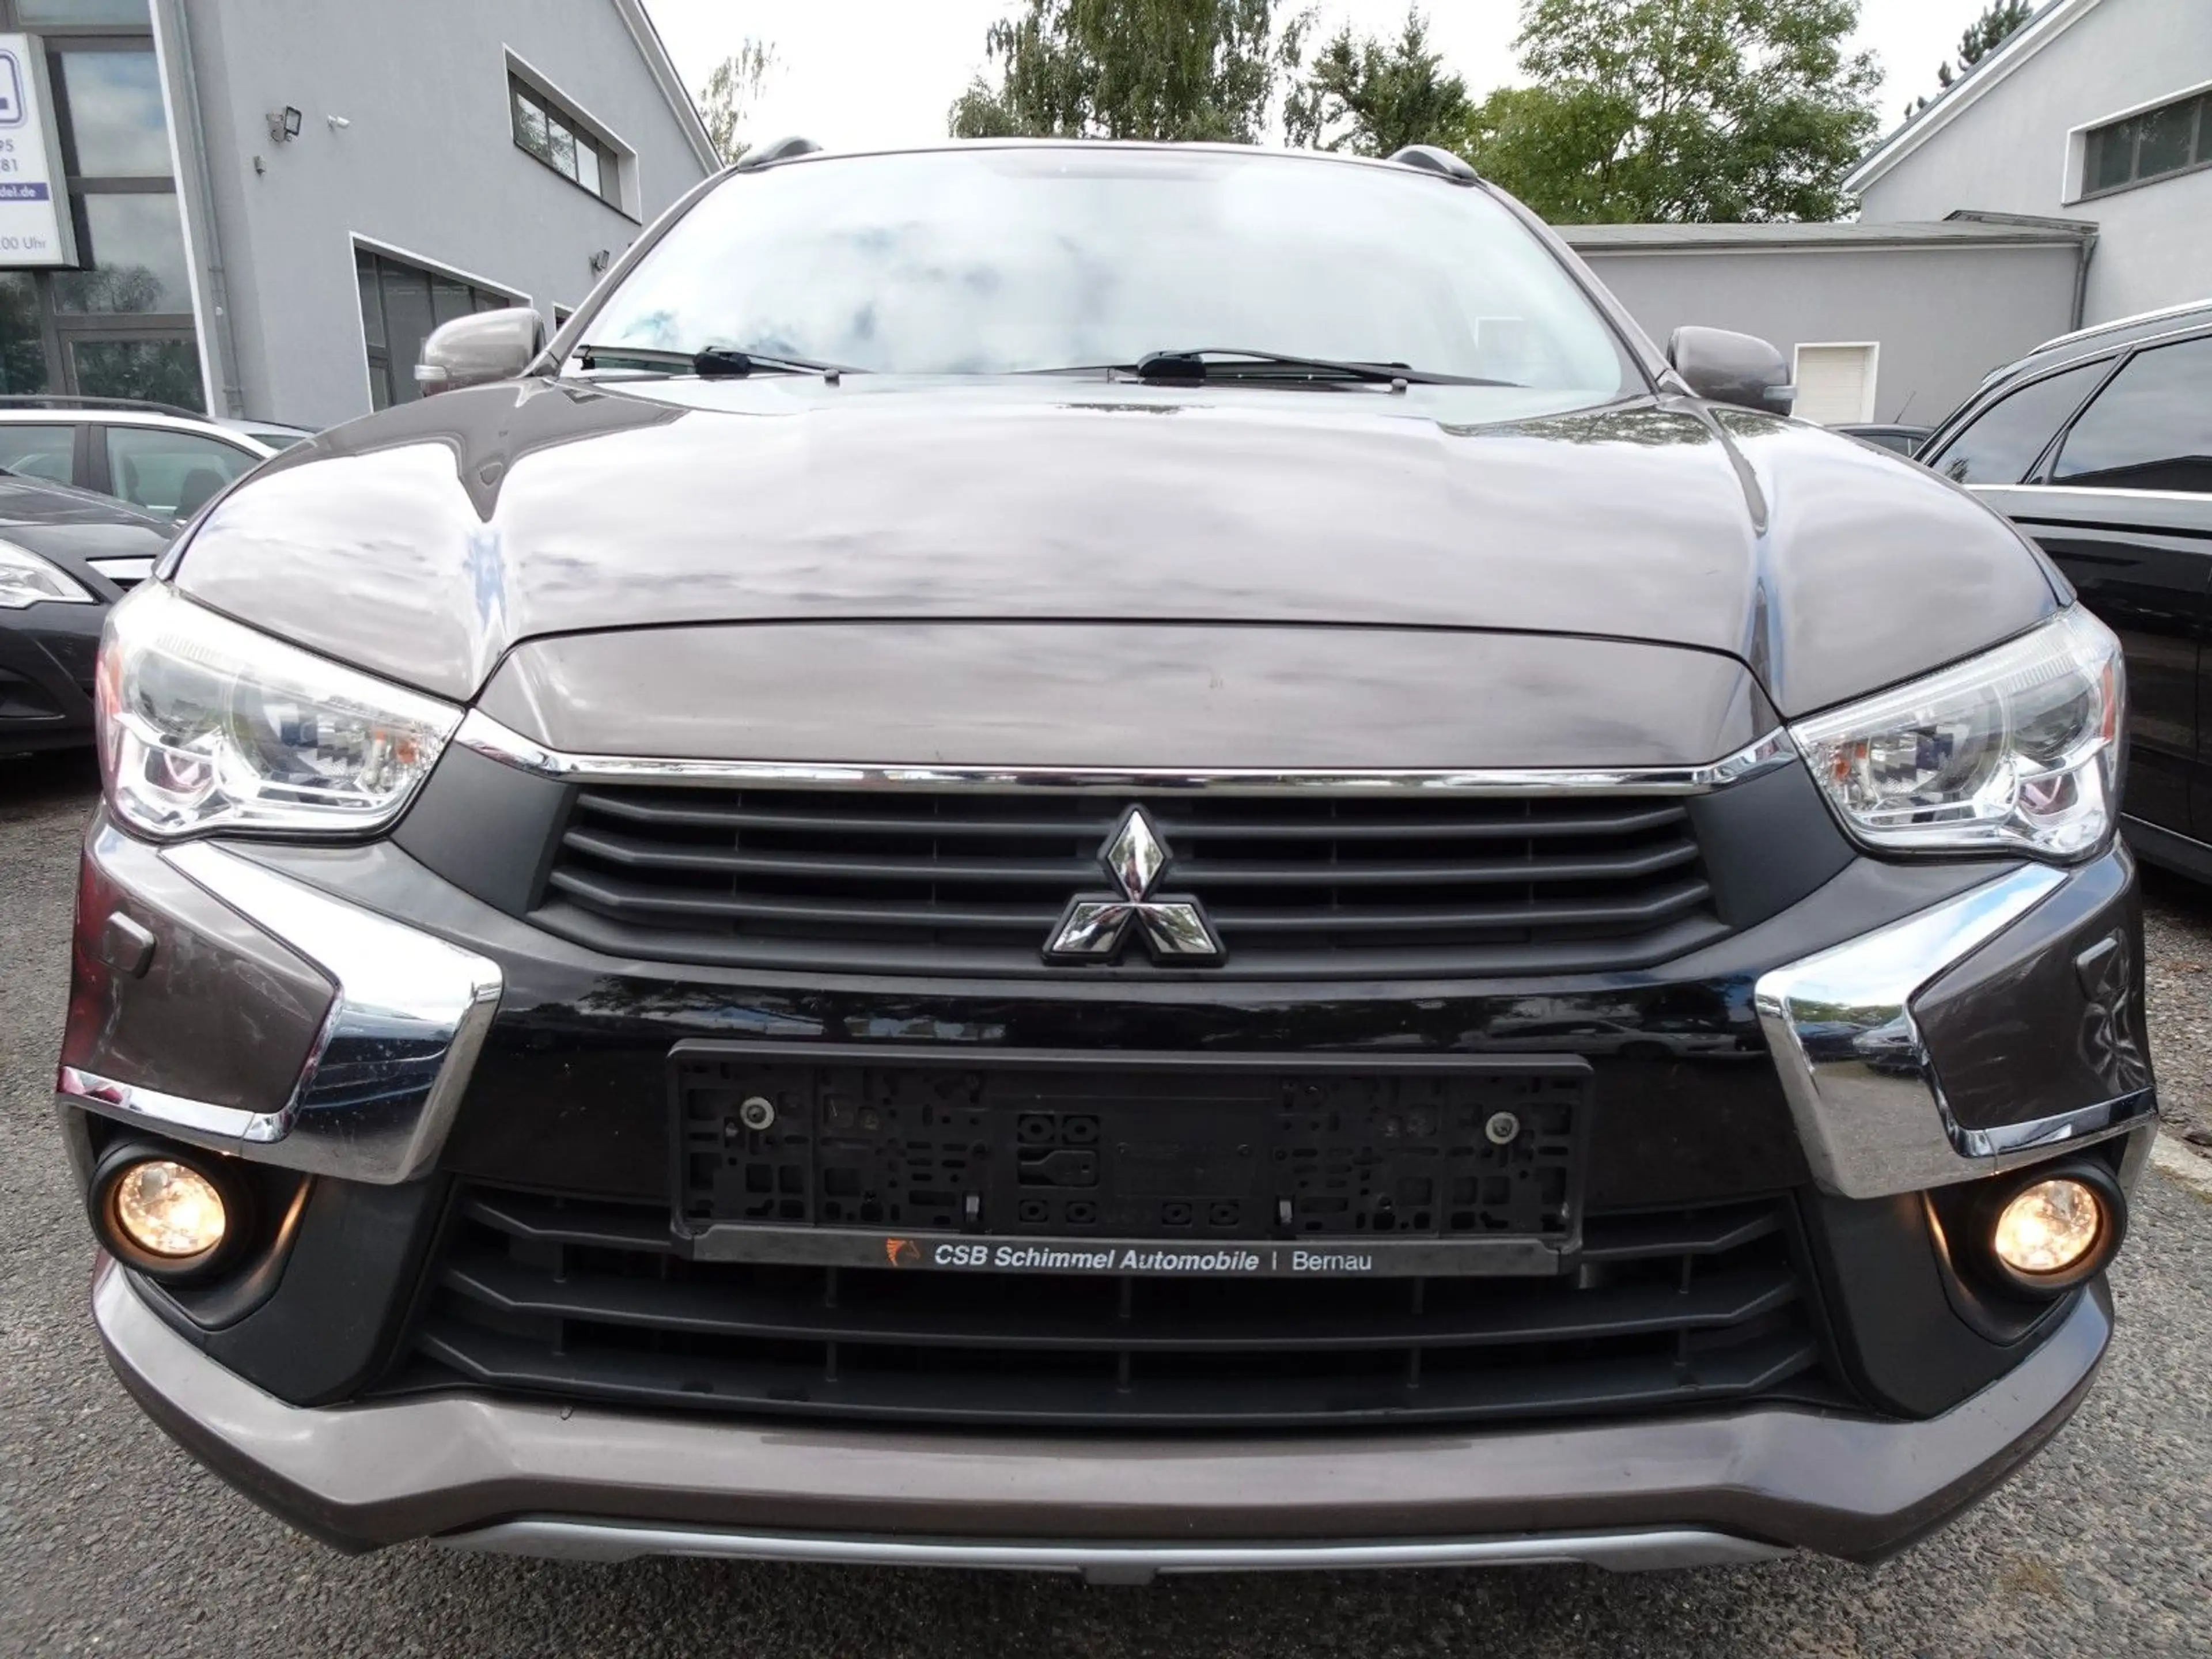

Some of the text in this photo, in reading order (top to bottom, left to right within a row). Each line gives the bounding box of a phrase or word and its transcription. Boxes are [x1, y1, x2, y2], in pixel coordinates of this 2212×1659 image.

[23, 235, 46, 249] Uhr
[934, 1244, 988, 1266] CSB
[994, 1245, 1116, 1269] Schimmel
[1119, 1249, 1260, 1271] Automobile
[1292, 1251, 1372, 1271] Bernau
